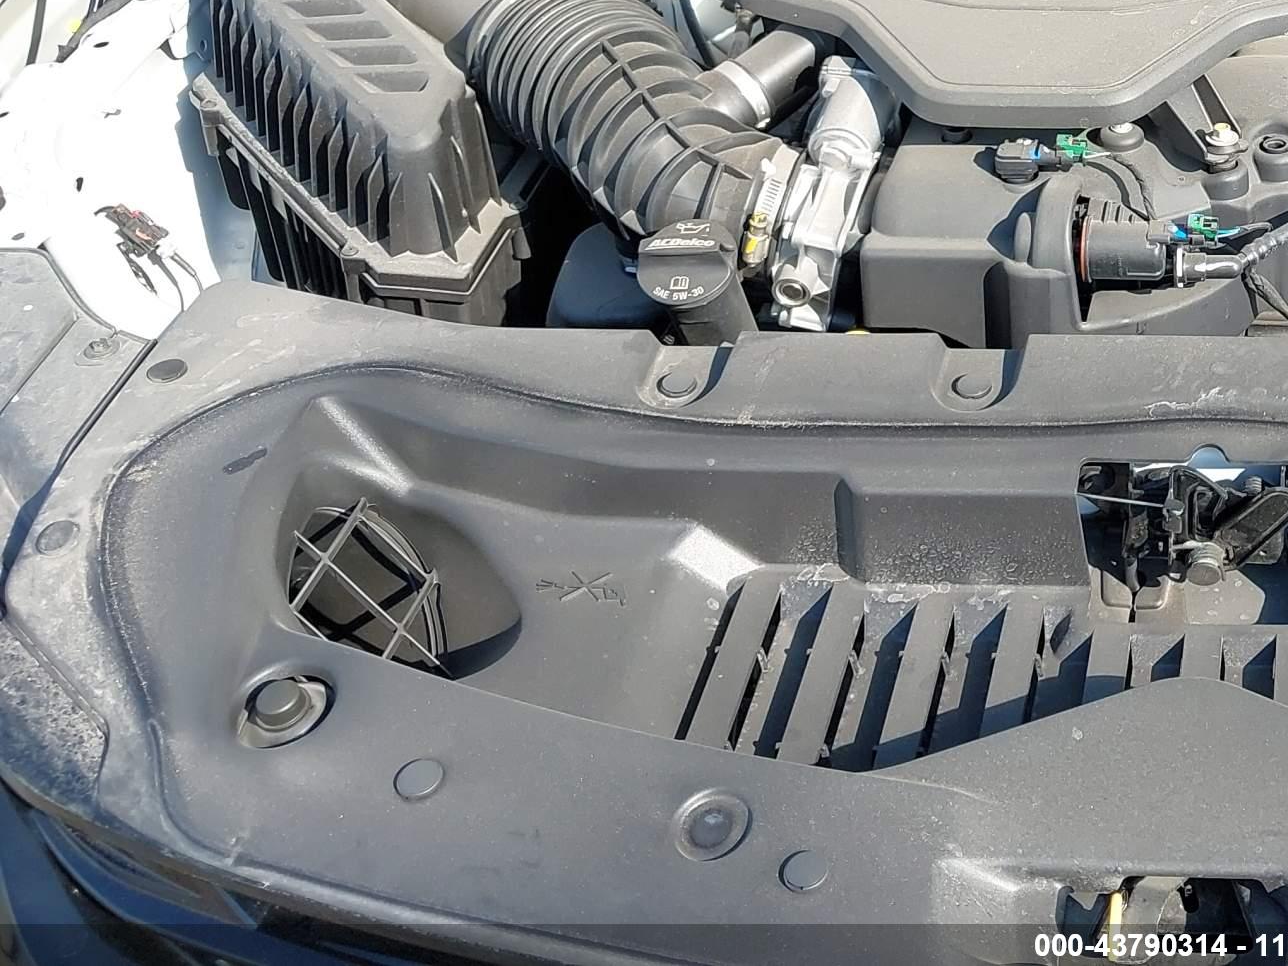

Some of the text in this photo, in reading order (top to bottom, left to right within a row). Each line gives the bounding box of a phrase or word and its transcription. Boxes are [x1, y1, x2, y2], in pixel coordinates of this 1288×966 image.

[648, 237, 716, 248] ACDelco
[653, 286, 705, 301] SAE 5W-30
